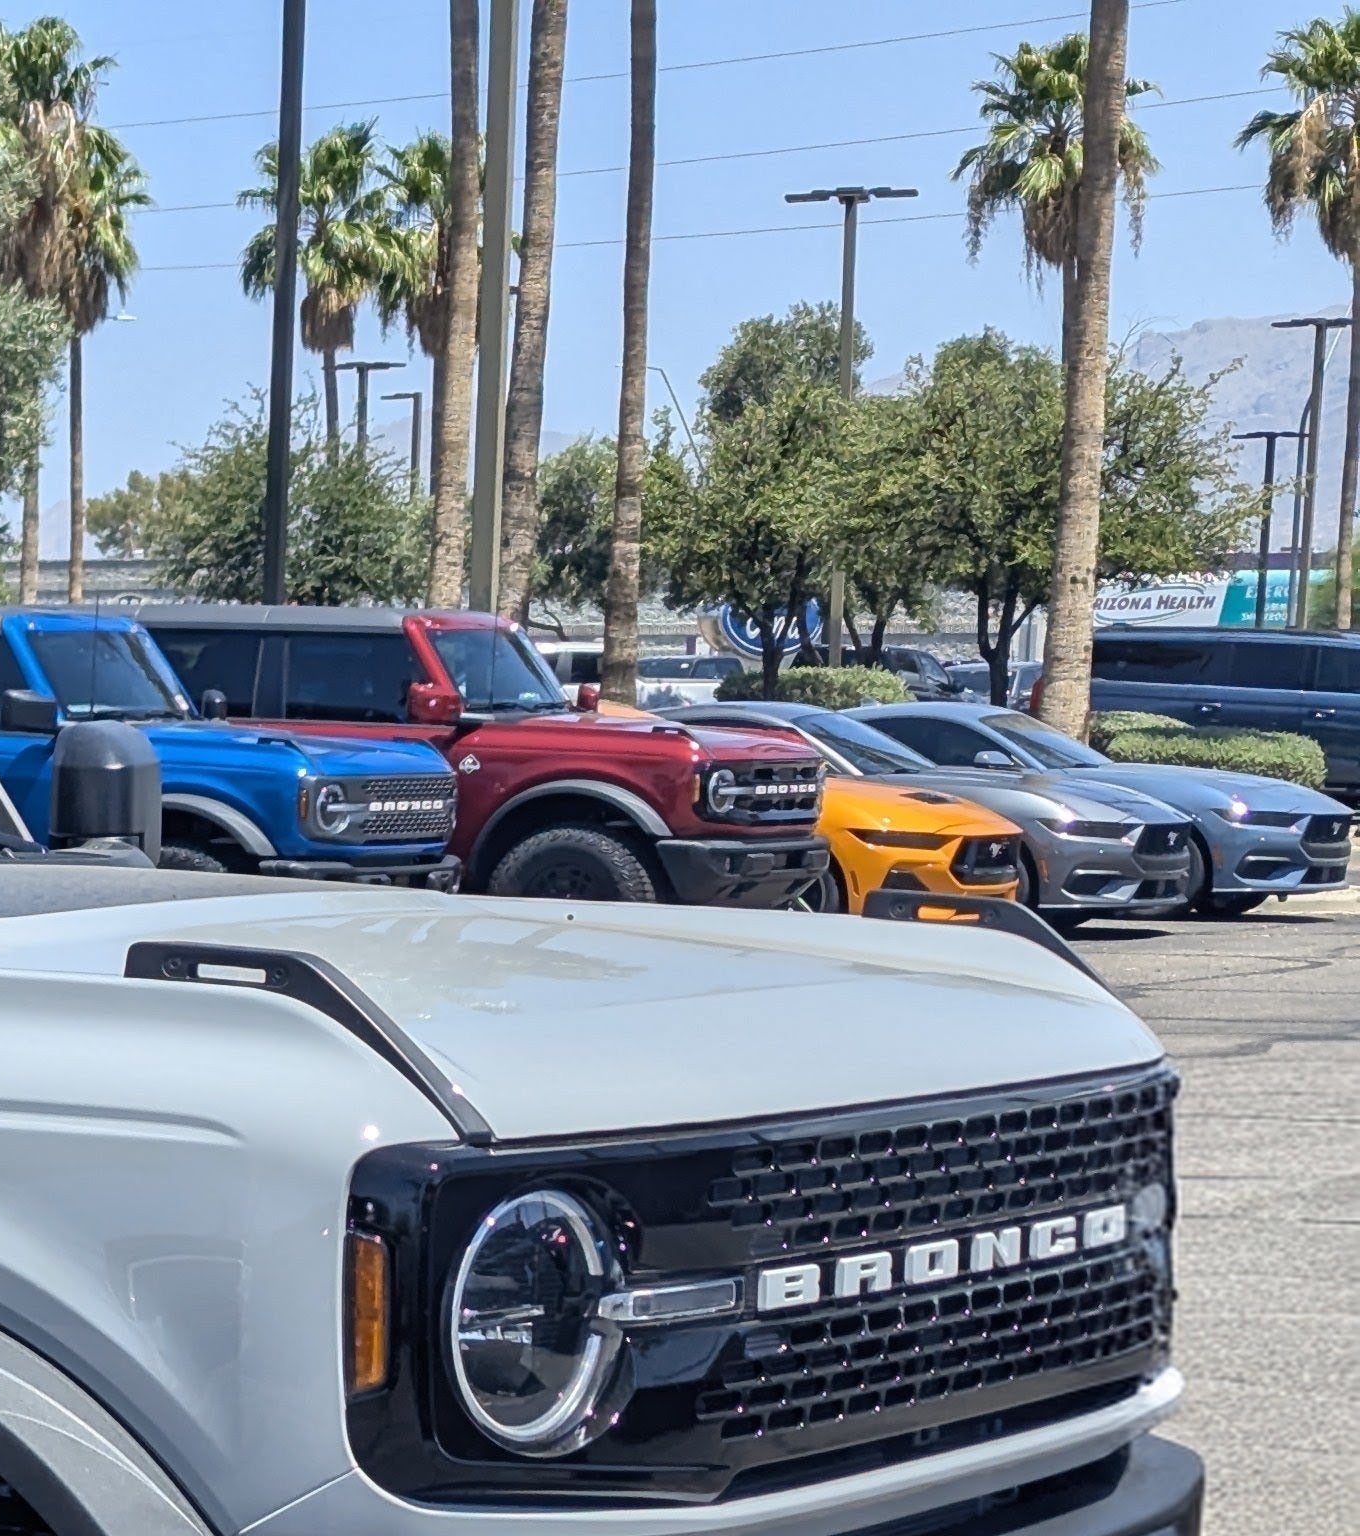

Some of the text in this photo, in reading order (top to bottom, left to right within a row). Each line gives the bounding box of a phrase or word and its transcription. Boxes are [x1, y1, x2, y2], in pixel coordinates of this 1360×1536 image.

[1093, 595, 1216, 610] RIZONA HEALTH
[757, 1204, 1127, 1312] BRONCO
